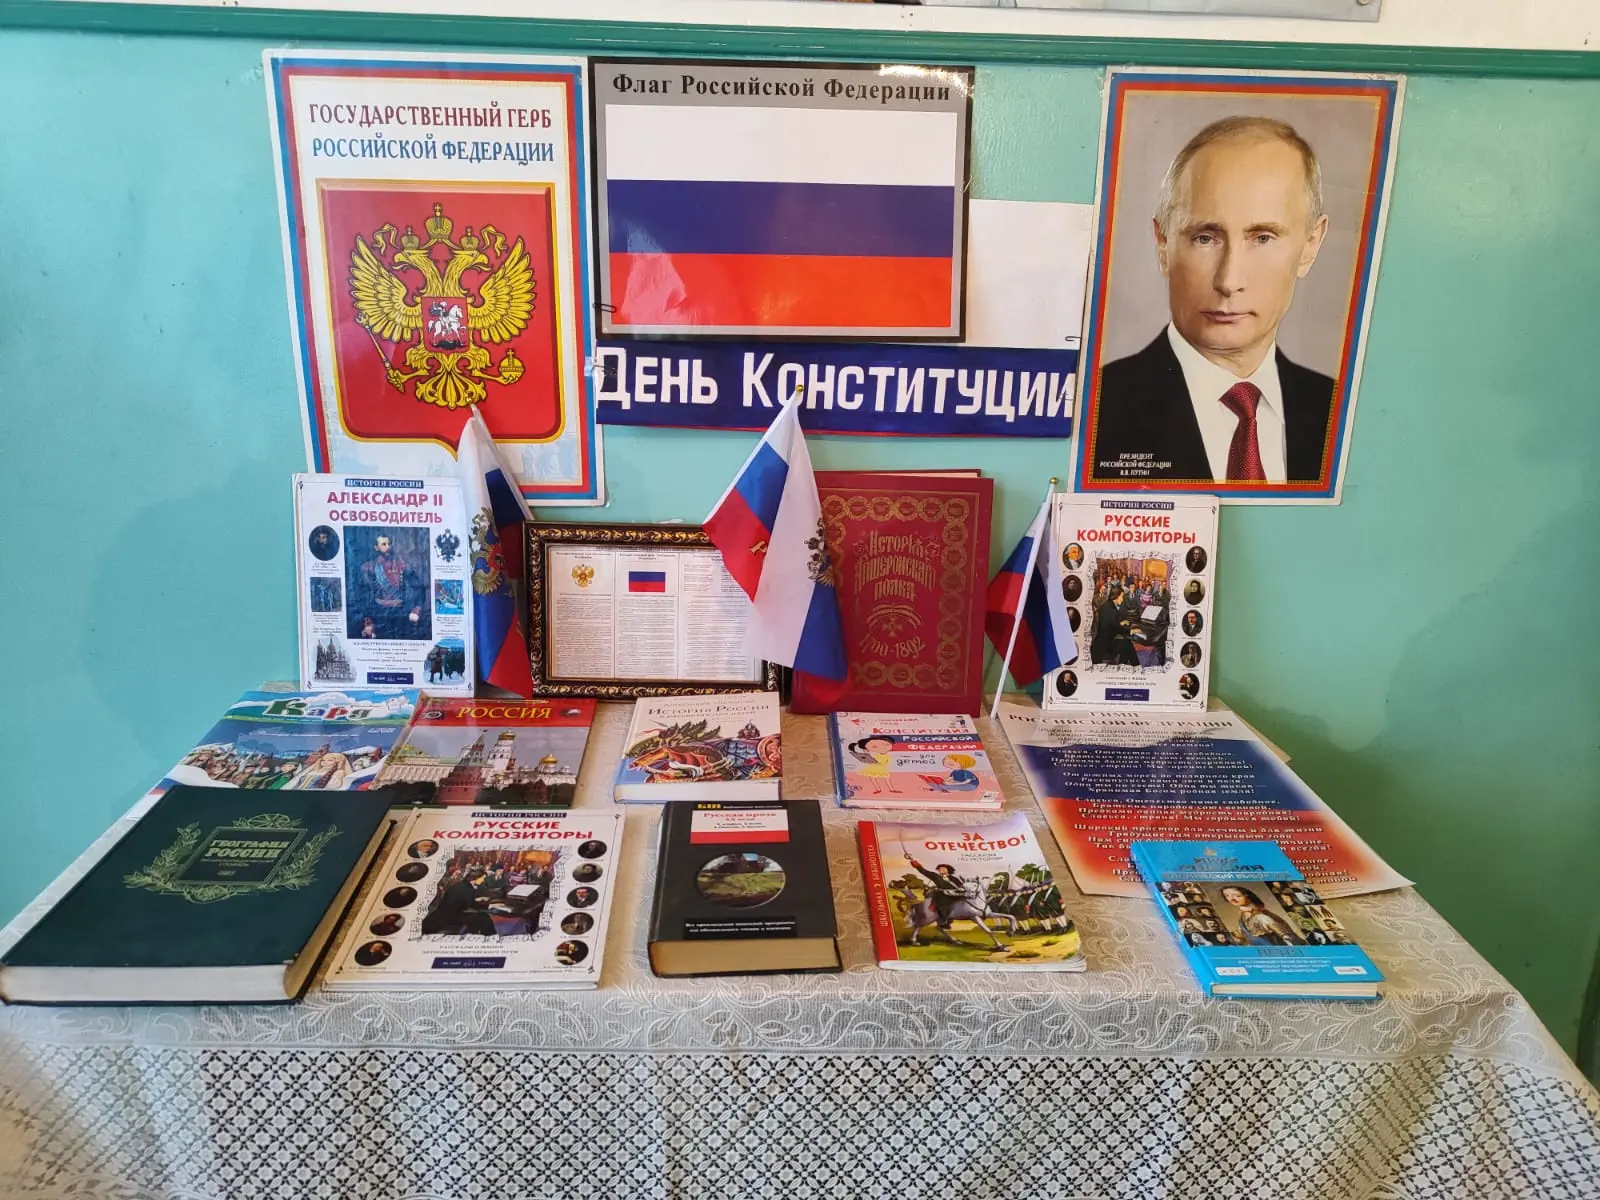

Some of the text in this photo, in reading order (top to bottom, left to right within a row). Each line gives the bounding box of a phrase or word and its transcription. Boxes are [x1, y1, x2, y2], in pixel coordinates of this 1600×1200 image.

[612, 73, 951, 104] Флаг Российской Федерации
[309, 100, 552, 129] ГОСУДАРСТВЕННЫЙ ГЕРБ
[312, 133, 555, 166] РОССИЙСКОЙ ФЕДЕРАЦИИ
[1119, 453, 1154, 461] ПРЕЗИДЕНТ
[1099, 459, 1172, 470] РОССИЙСКОЙ ФЕДЕРАЦИИ
[347, 479, 422, 489] ИСТОРИЯ РОССИИ
[327, 491, 429, 508] АЛЕКСАНДР
[1103, 501, 1173, 510] ИСТОРИЯ РОССИИ
[328, 509, 443, 525] ОСВОБОДИТЕЛЬ
[1104, 514, 1171, 528] РУССКИЕ
[1076, 529, 1196, 544] КОМПОЗИТОРЫ
[456, 706, 553, 719] РОССИЯ
[473, 821, 561, 830] РУССКИЕ
[1074, 823, 1129, 831] Широкий
[432, 830, 593, 841] КОМПОЗИТОРЫ
[961, 832, 985, 842] ЗА
[209, 839, 291, 849] ГЕОГРАФИЯ
[924, 834, 1027, 852] ОТЕЧЕСТВО!
[203, 847, 283, 858] РОССИИ
